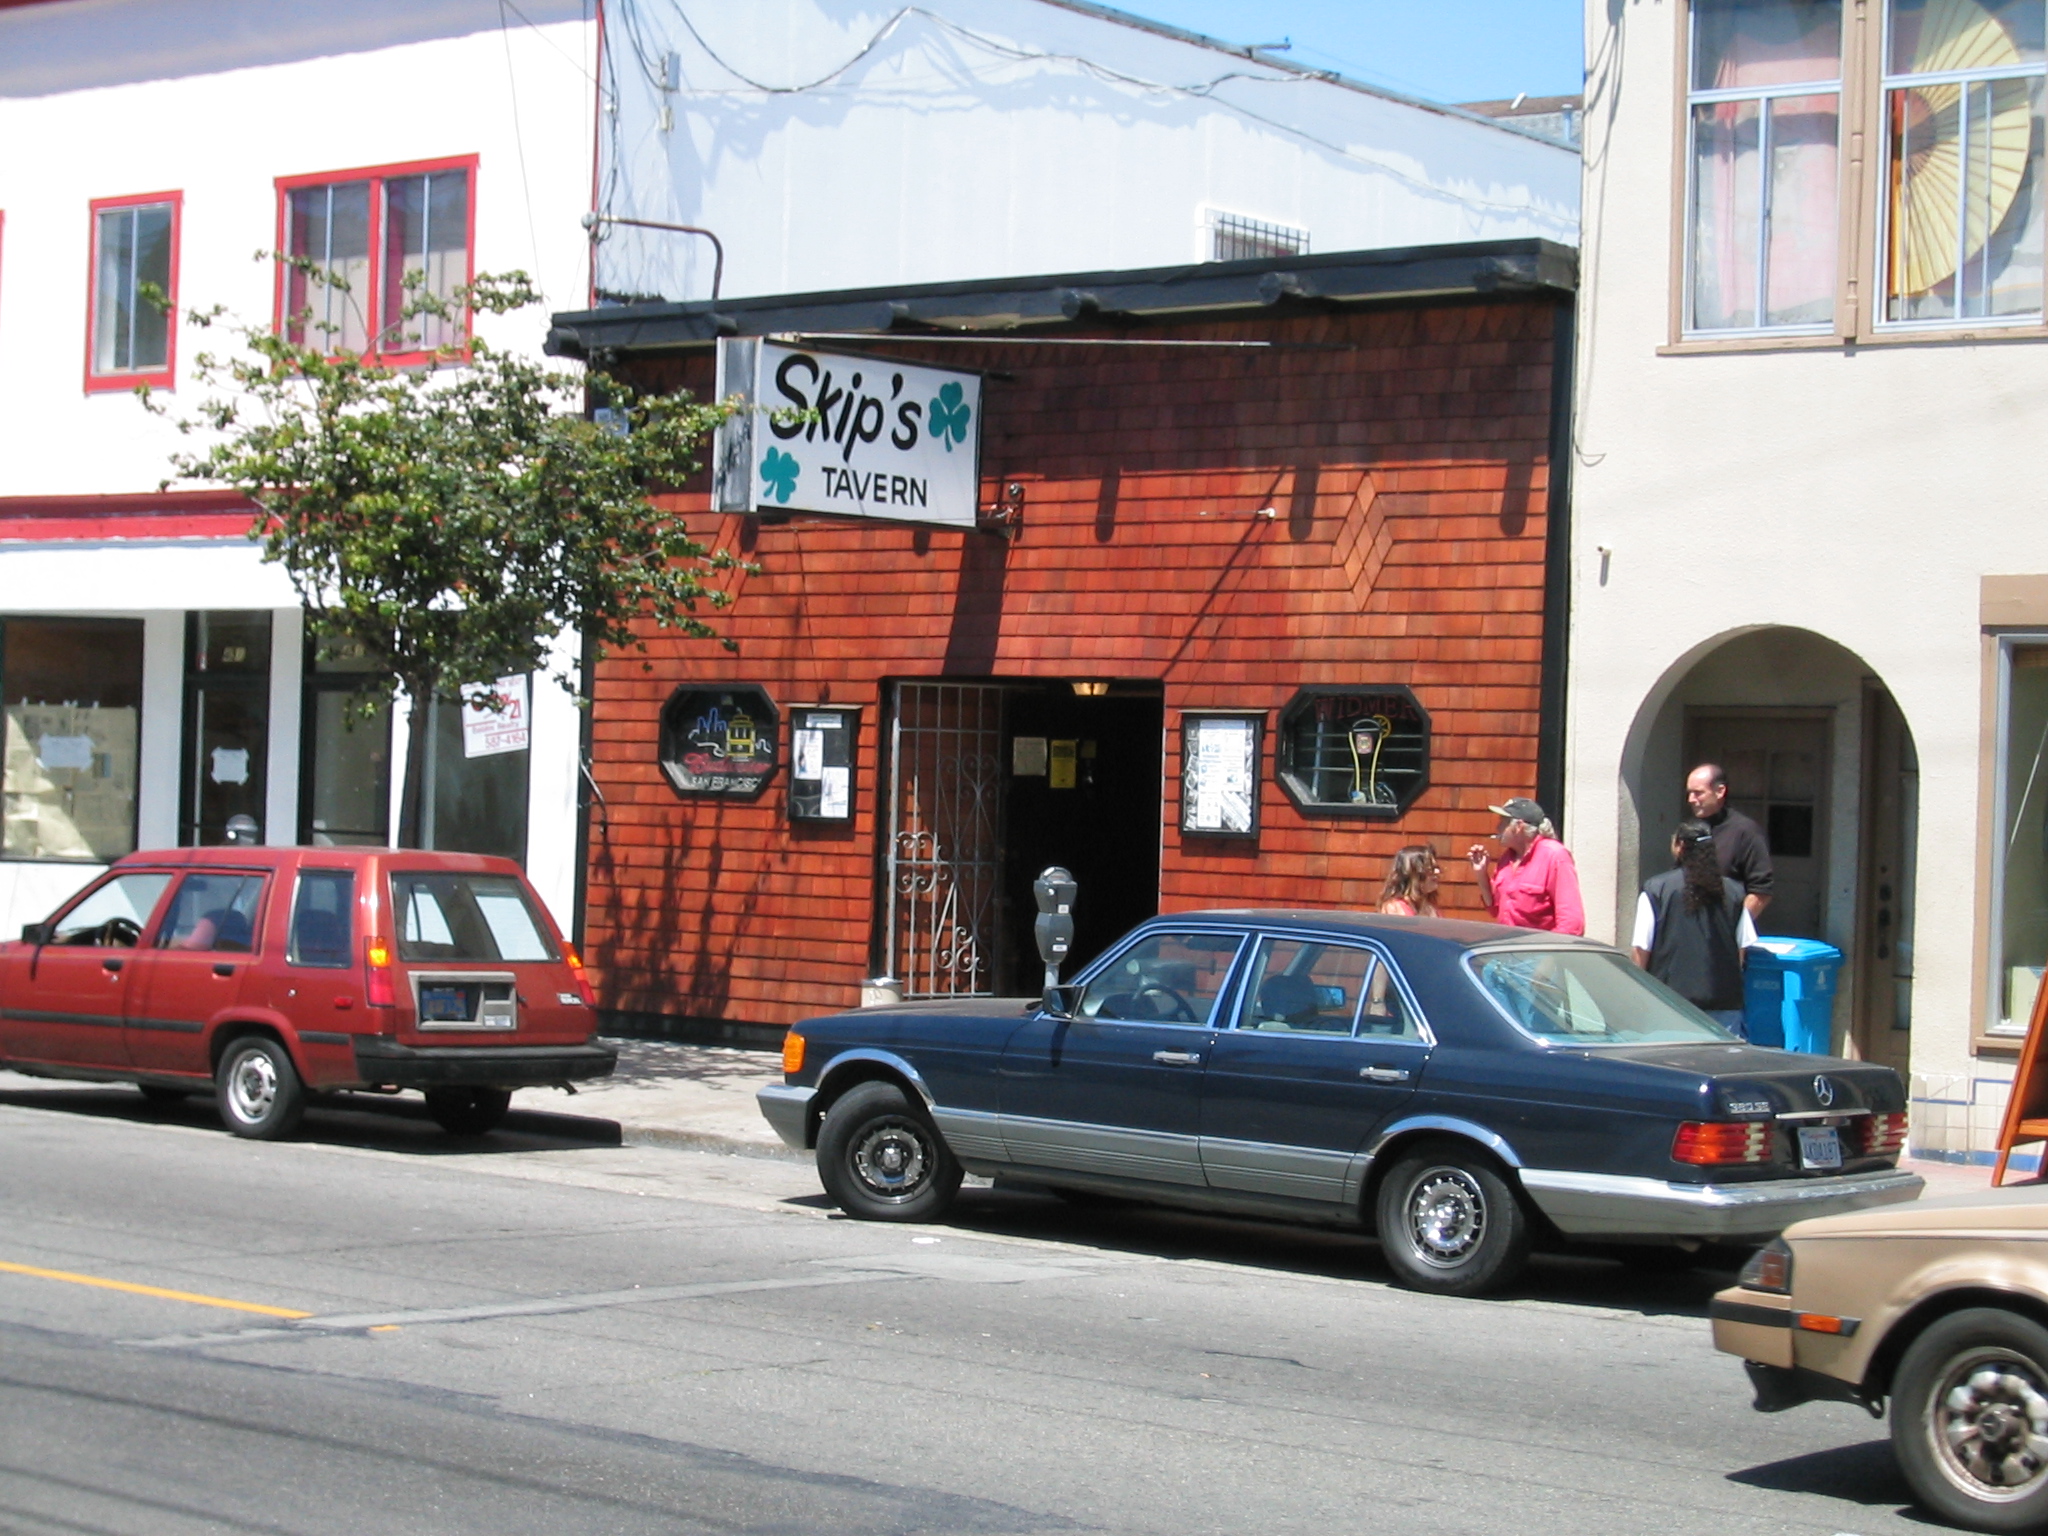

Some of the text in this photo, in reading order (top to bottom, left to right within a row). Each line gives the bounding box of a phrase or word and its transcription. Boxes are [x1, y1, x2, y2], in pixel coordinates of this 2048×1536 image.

[770, 353, 922, 462] Skip's
[822, 466, 928, 507] TAVERN
[510, 699, 521, 718] 21
[1315, 695, 1419, 721] WIDMER
[691, 776, 709, 788] SAN
